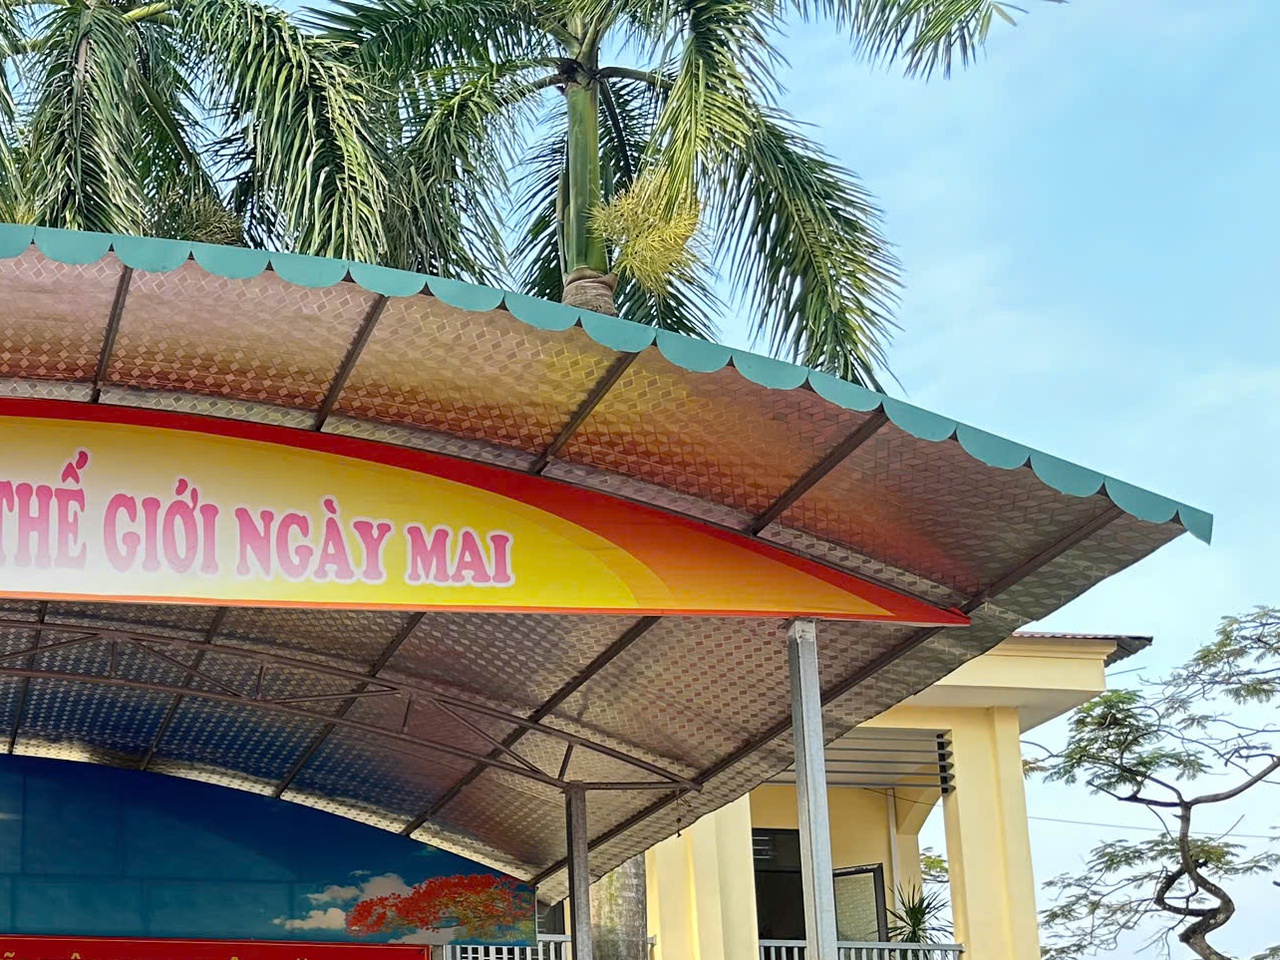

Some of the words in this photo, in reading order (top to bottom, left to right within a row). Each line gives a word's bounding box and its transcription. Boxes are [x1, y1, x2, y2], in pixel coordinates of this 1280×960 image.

[103, 477, 219, 573] GIỚI
[235, 497, 392, 581] NGÀY
[407, 526, 513, 584] MAI
